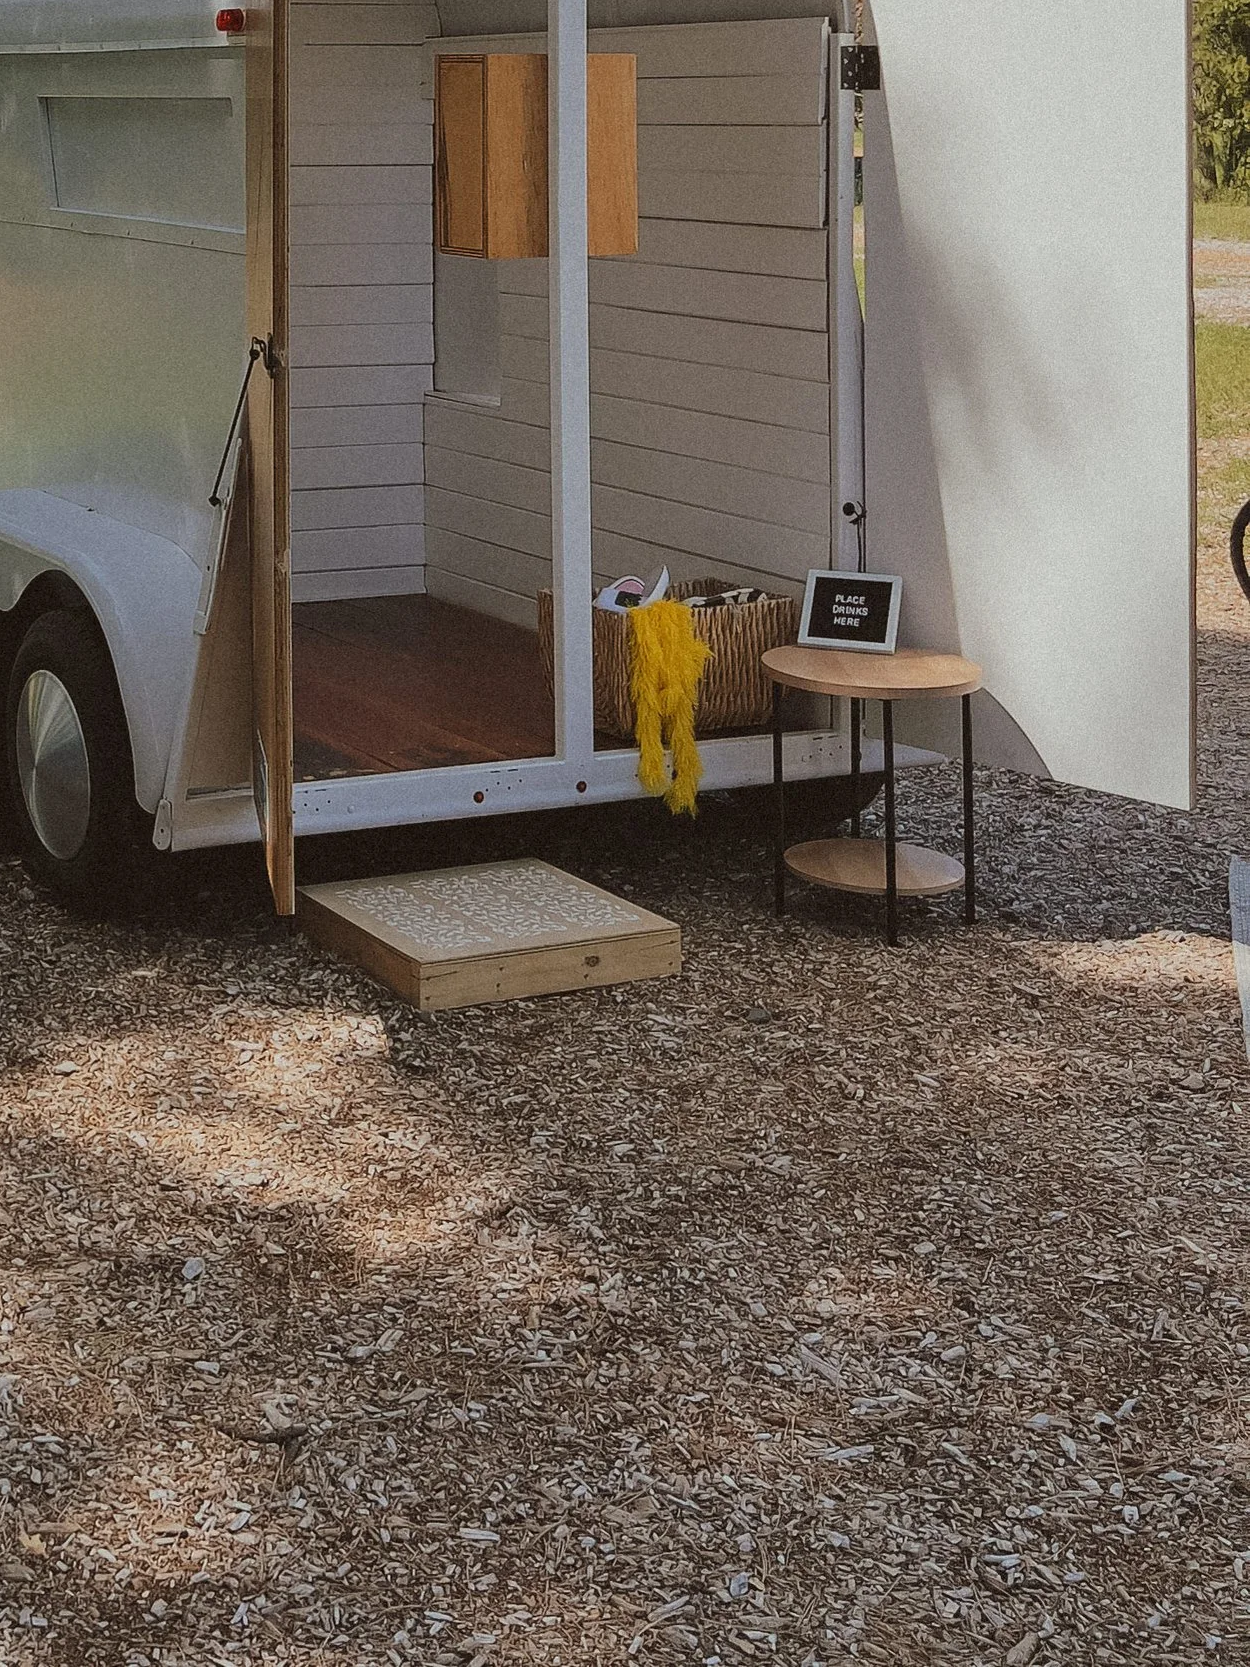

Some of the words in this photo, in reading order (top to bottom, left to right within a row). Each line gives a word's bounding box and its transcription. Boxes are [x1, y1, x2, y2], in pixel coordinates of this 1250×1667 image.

[835, 594, 866, 605] PLACE
[832, 604, 869, 616] DRINKS
[833, 616, 860, 627] HERE
